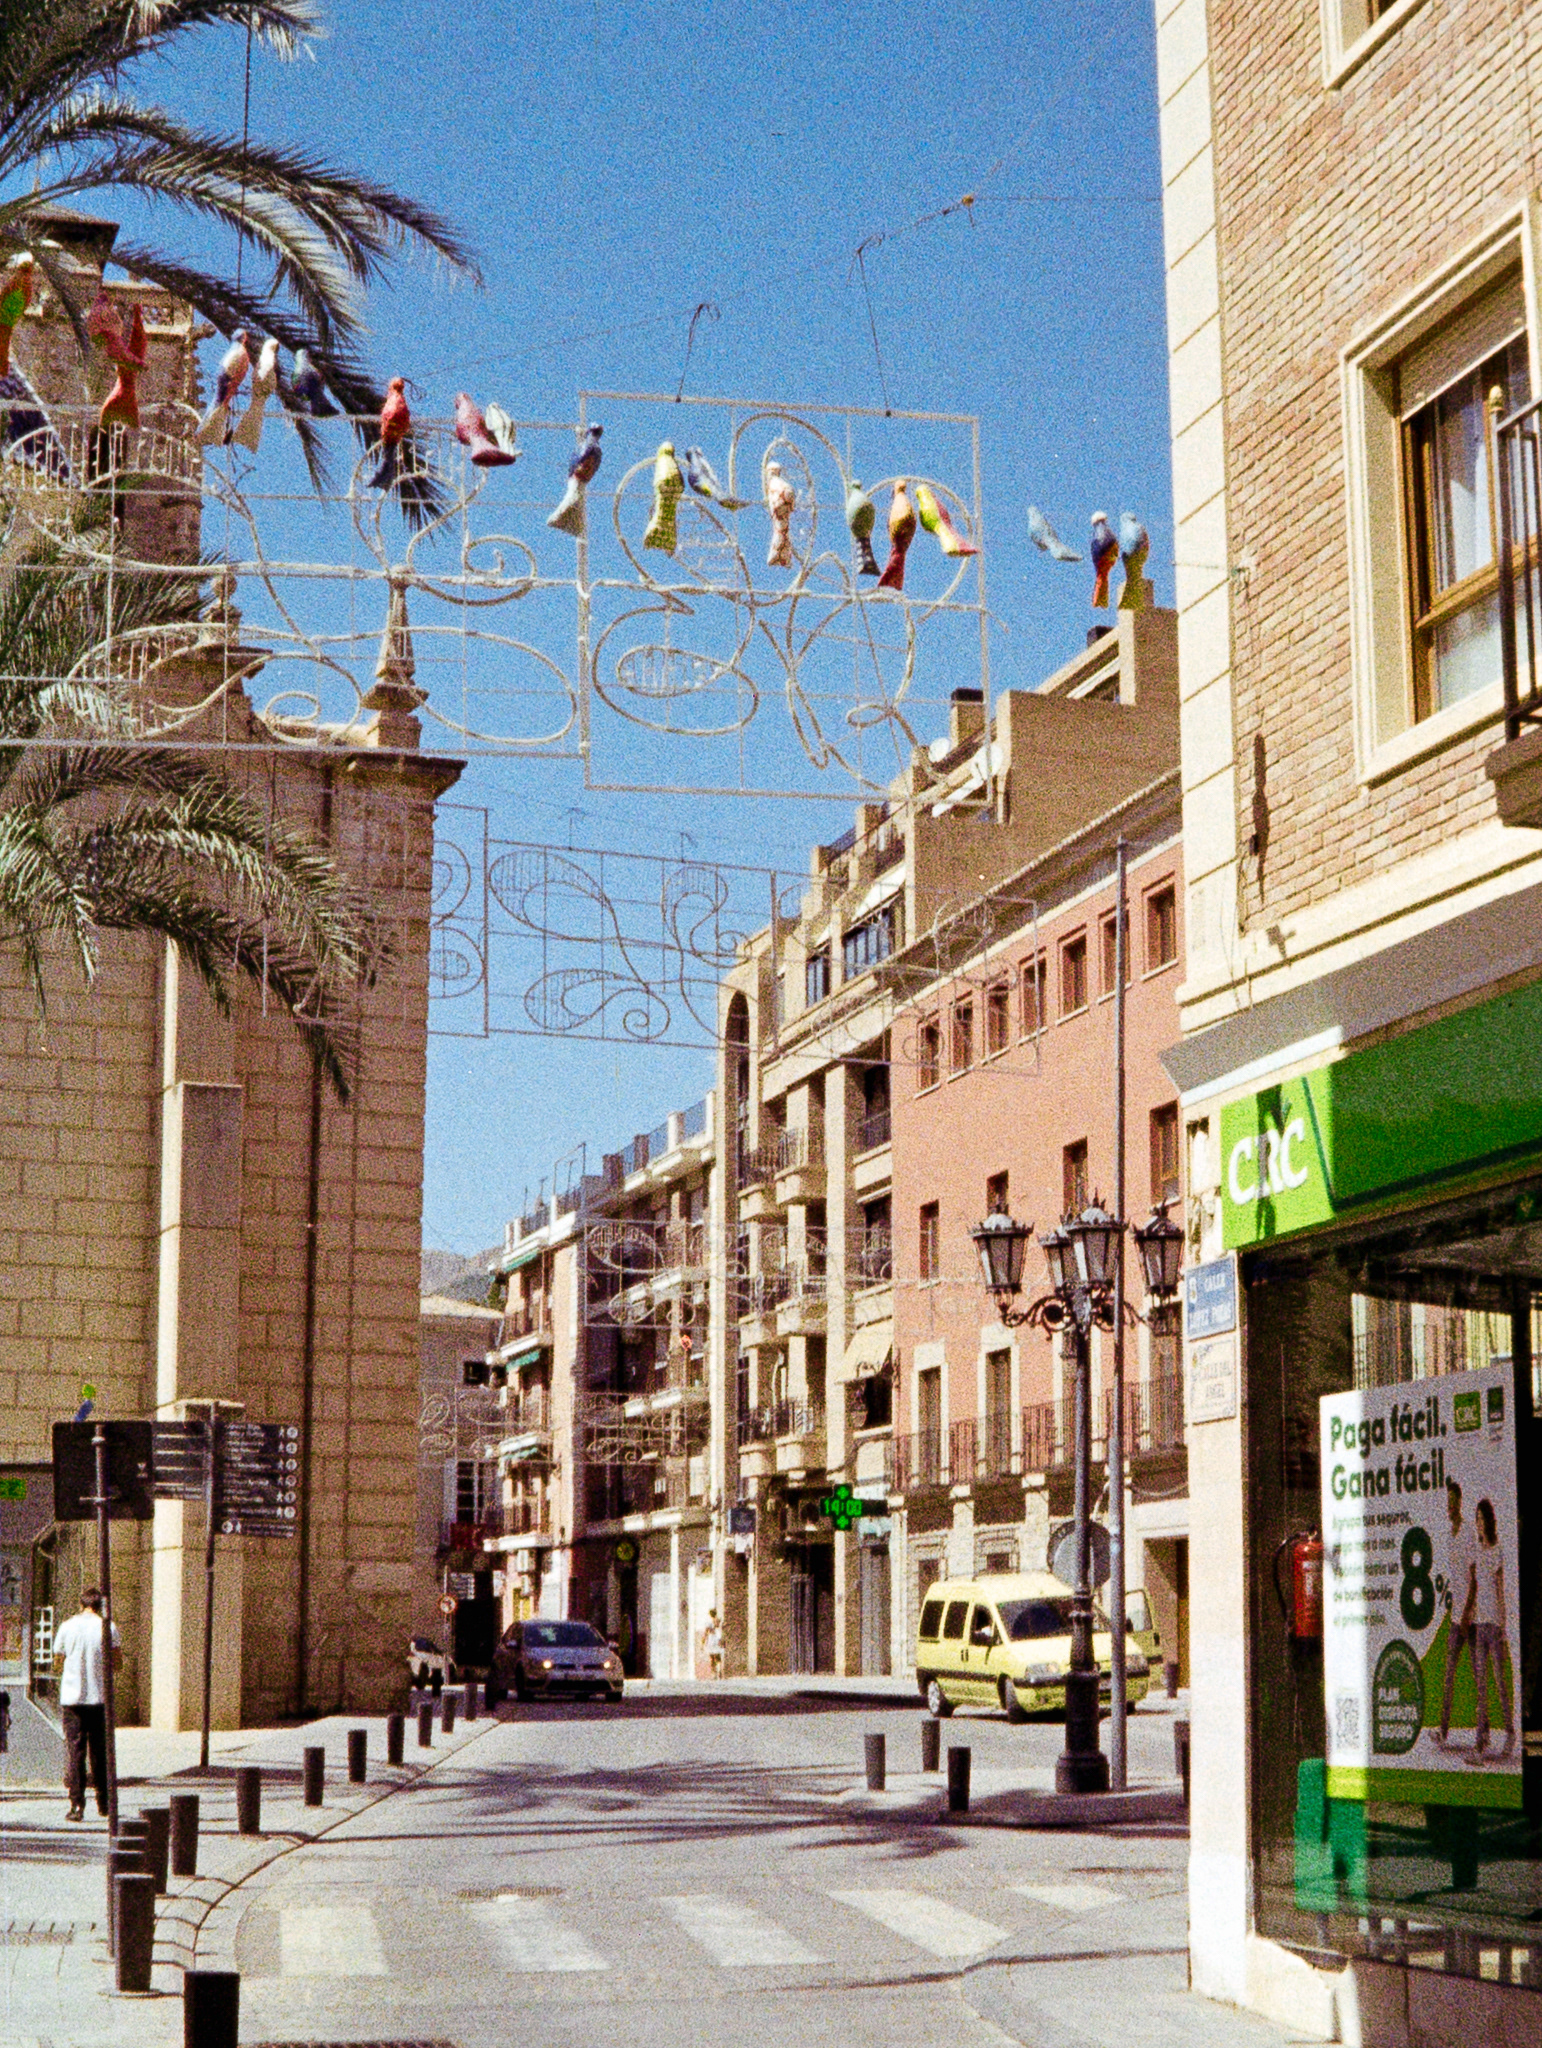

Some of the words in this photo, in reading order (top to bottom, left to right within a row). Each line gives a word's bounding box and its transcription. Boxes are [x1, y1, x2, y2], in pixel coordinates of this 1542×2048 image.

[1228, 1117, 1308, 1206] CRC
[1330, 1415, 1386, 1459] Paga
[1390, 1395, 1448, 1444] fácil.
[1330, 1463, 1390, 1501] Gana
[1394, 1447, 1452, 1494] fácil.
[824, 1498, 863, 1517] 14:00
[1401, 1526, 1453, 1631] 8%
